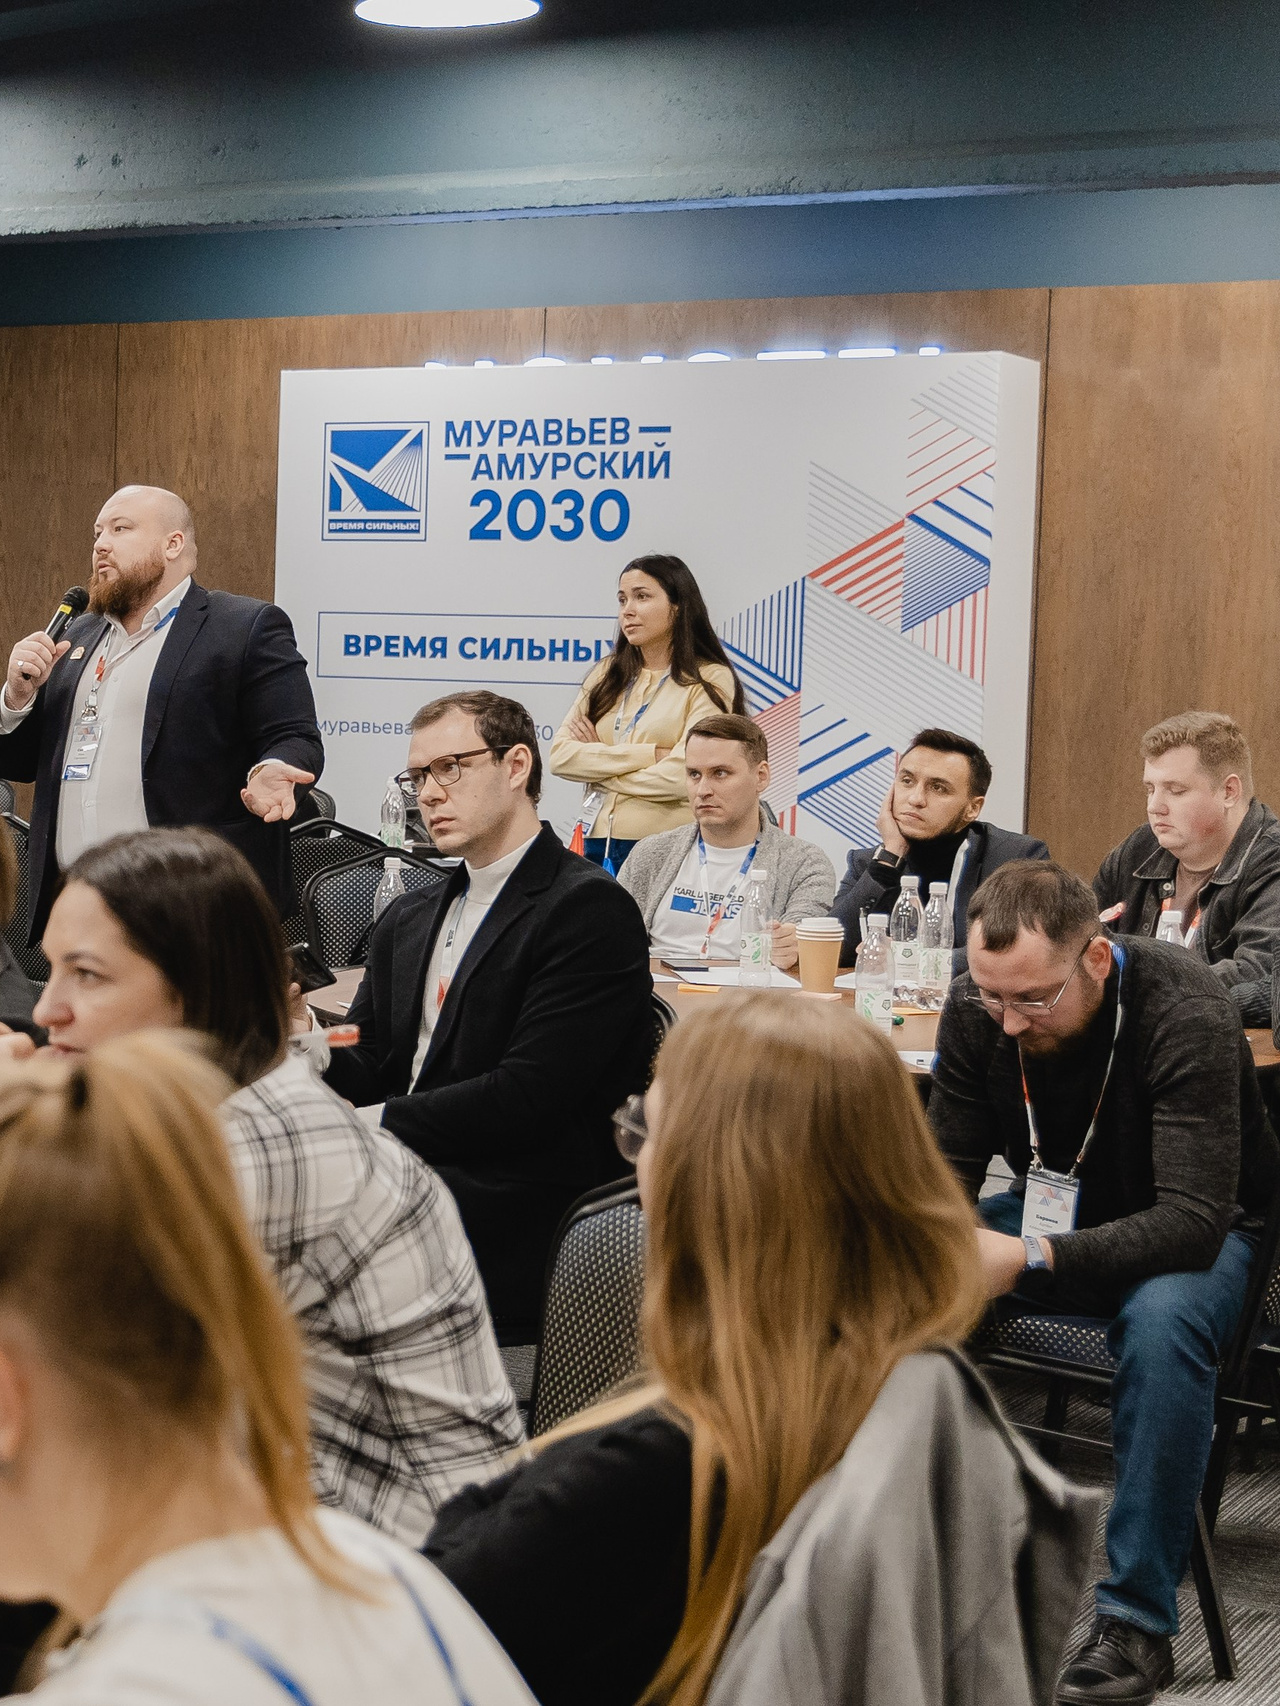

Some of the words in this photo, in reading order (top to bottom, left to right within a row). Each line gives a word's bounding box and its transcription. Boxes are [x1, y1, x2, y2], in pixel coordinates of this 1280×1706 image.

[469, 488, 630, 542] 2030
[329, 522, 364, 530] ВРЕМЯ
[365, 522, 419, 531] СИЛЬНЫХ!
[343, 634, 448, 659] ВРЕМЯ
[458, 637, 615, 663] СИЛЬНЫ
[315, 719, 414, 736] муравьева
[674, 887, 696, 897] KARL
